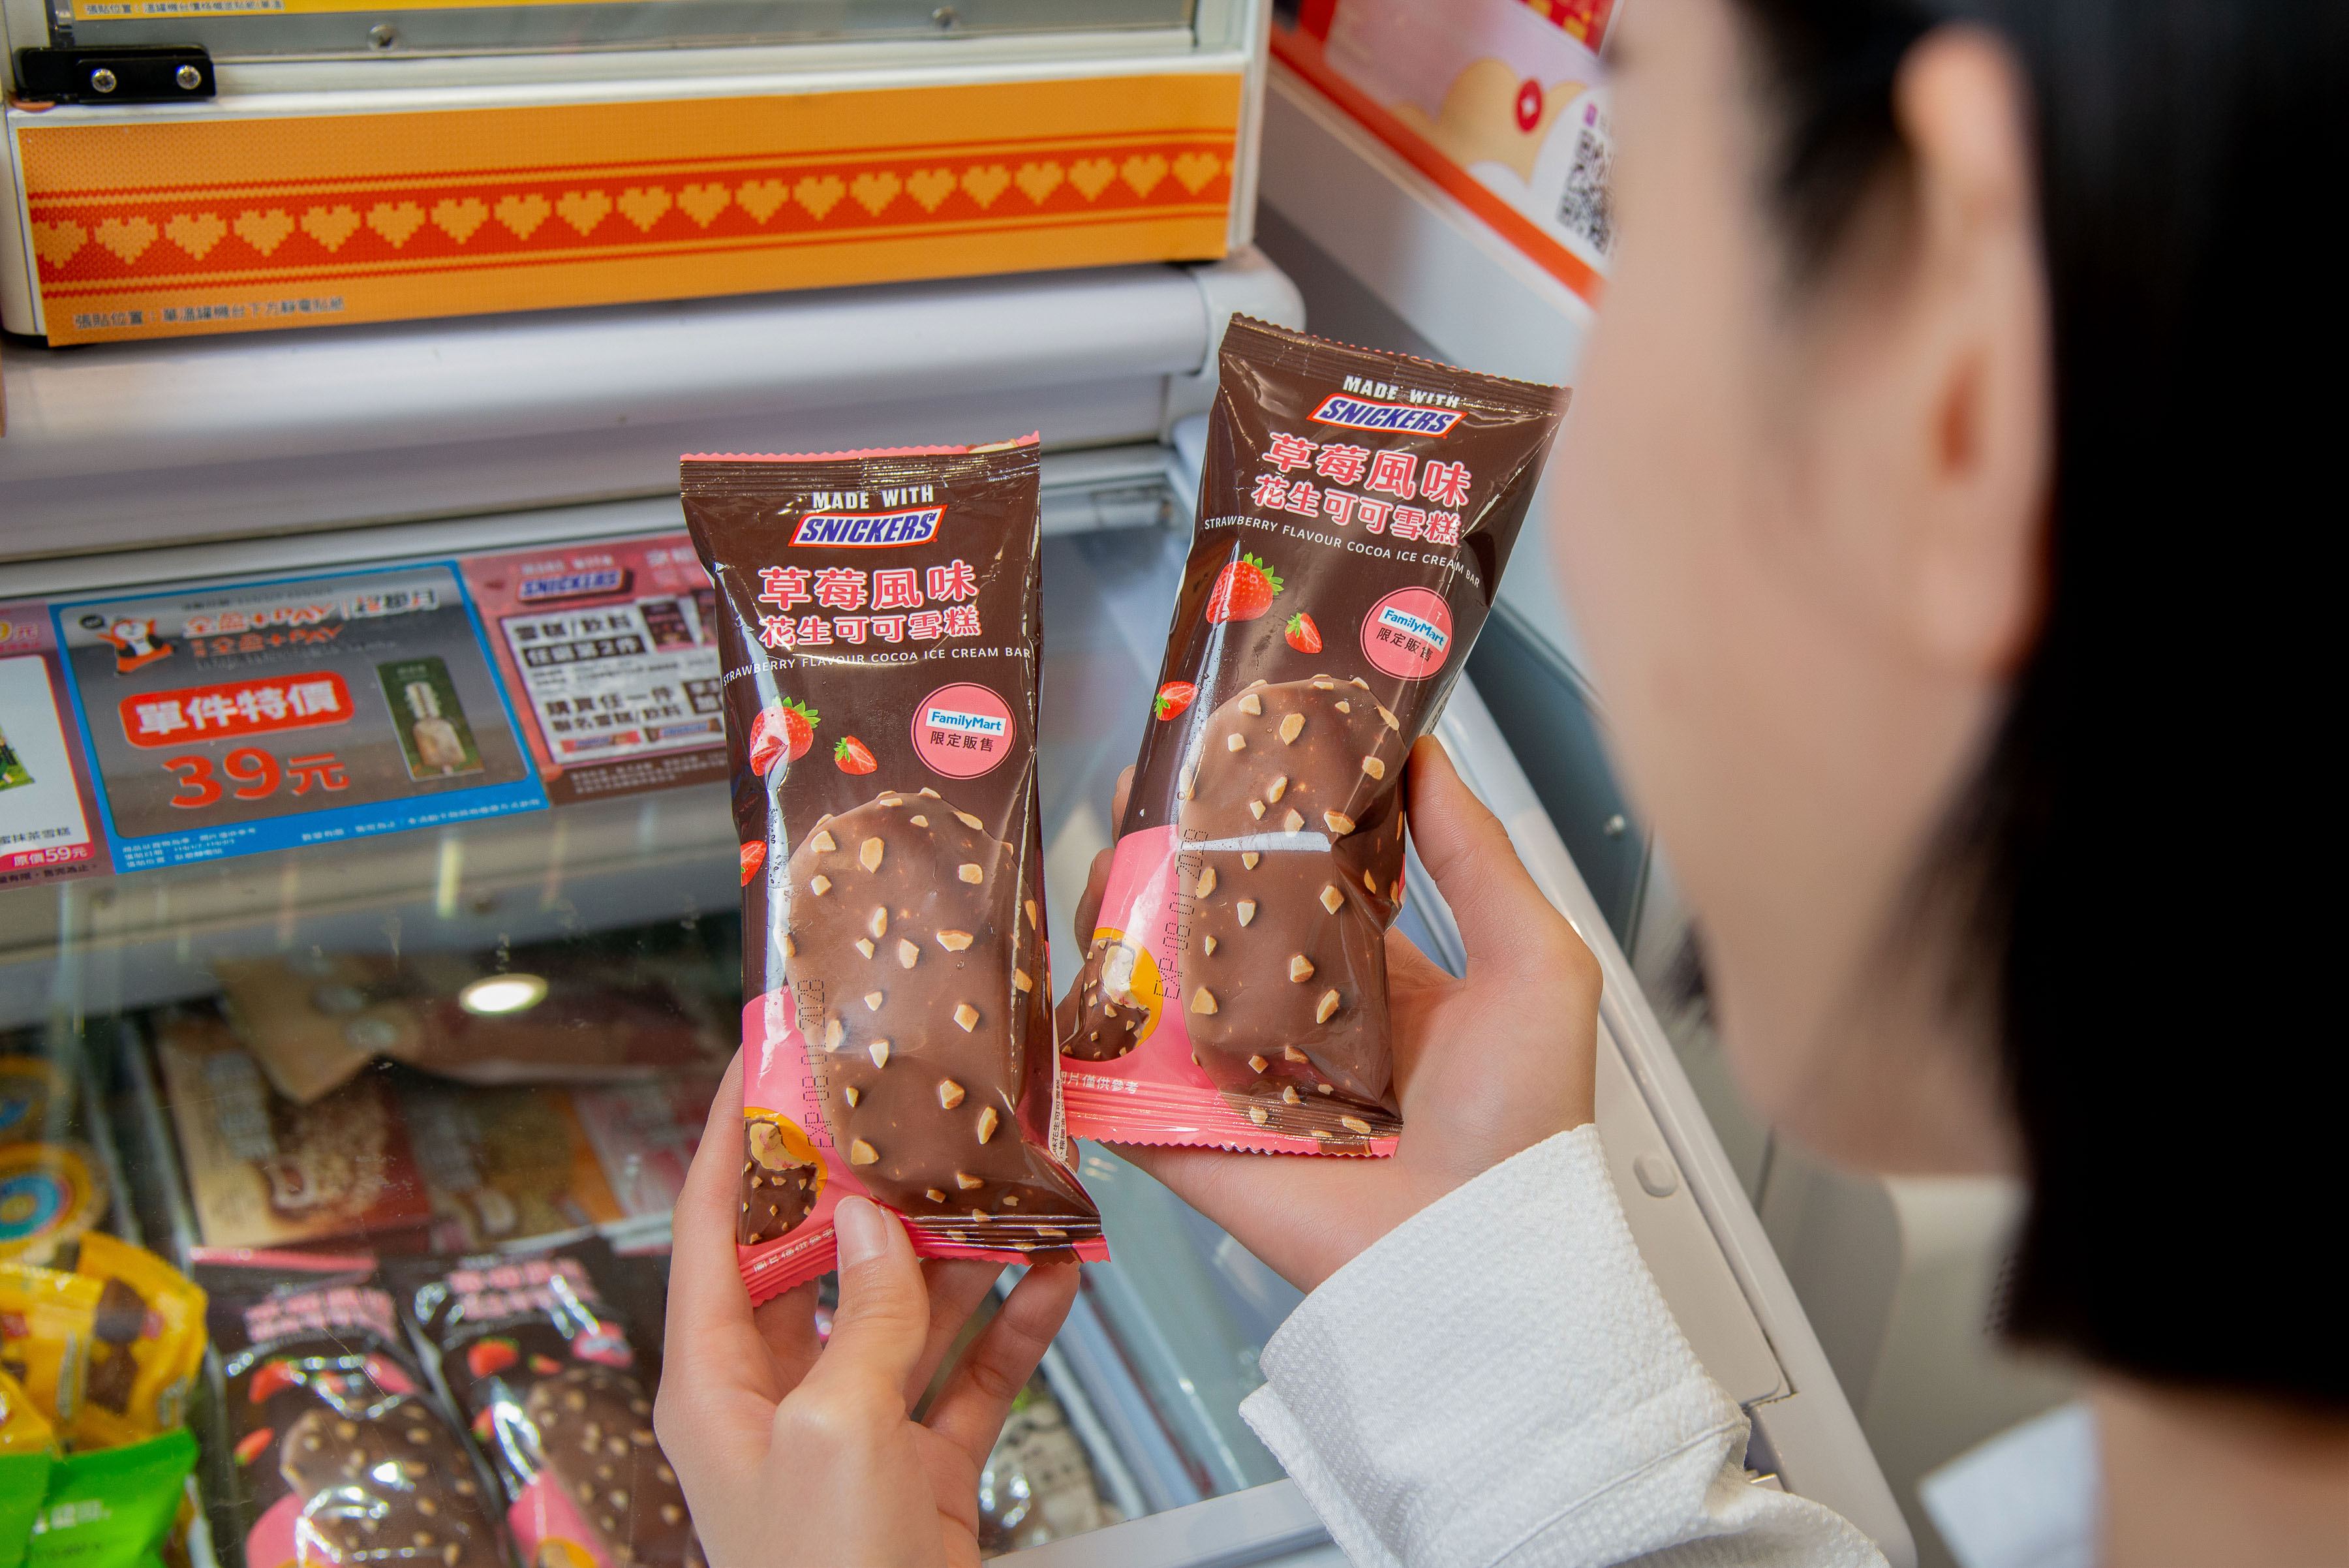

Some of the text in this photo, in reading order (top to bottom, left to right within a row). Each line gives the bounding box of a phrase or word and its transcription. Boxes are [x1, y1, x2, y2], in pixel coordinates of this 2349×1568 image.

[1343, 375, 1460, 408] MADE WITH
[1319, 399, 1456, 433] SNICKERS
[1262, 432, 1472, 508] 草莓風味
[812, 485, 934, 509] MADE WITH
[1251, 474, 1462, 547] 花生可可雪糕
[799, 512, 938, 543] SNICKERS
[1205, 515, 1480, 588] STRAWBERRY FLAVOUR COCOA ICE CREAM BAR
[758, 559, 980, 611] 草莓風味
[758, 604, 982, 649] 花生可可雪糕
[1376, 627, 1434, 662] 限定販售
[1383, 609, 1445, 646] FamilyMart
[722, 647, 1031, 686] STRAWBERRY FLAVOUR COCOA ICE CREAM BAR
[134, 680, 341, 735] 單件特價
[931, 711, 1002, 731] FamilyMart
[930, 730, 994, 752] 限定販售
[161, 746, 350, 809] 39元
[13, 846, 89, 867] 原價59元
